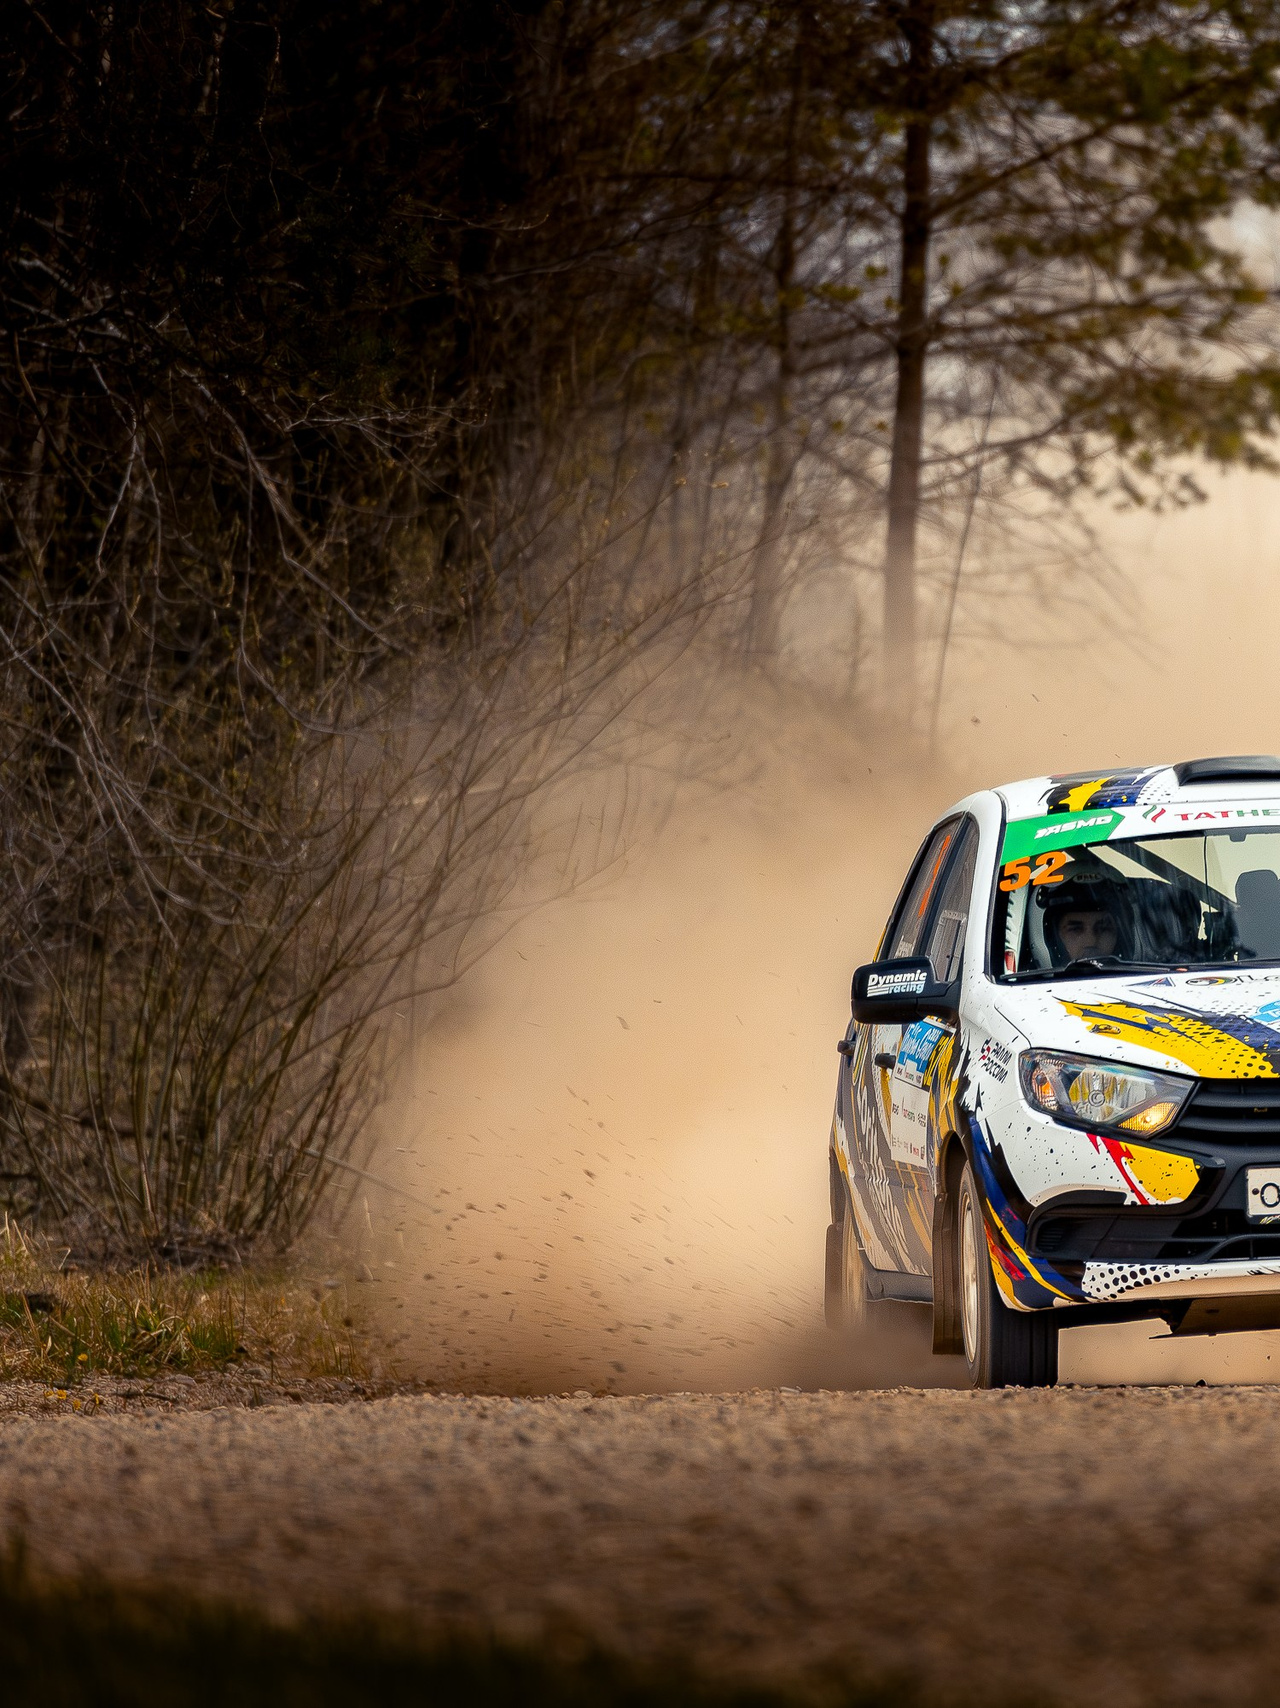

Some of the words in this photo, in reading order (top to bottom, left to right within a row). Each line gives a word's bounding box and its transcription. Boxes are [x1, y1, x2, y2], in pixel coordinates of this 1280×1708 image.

[999, 851, 1067, 892] 52
[868, 969, 928, 987] Dynamic
[888, 983, 925, 994] racing
